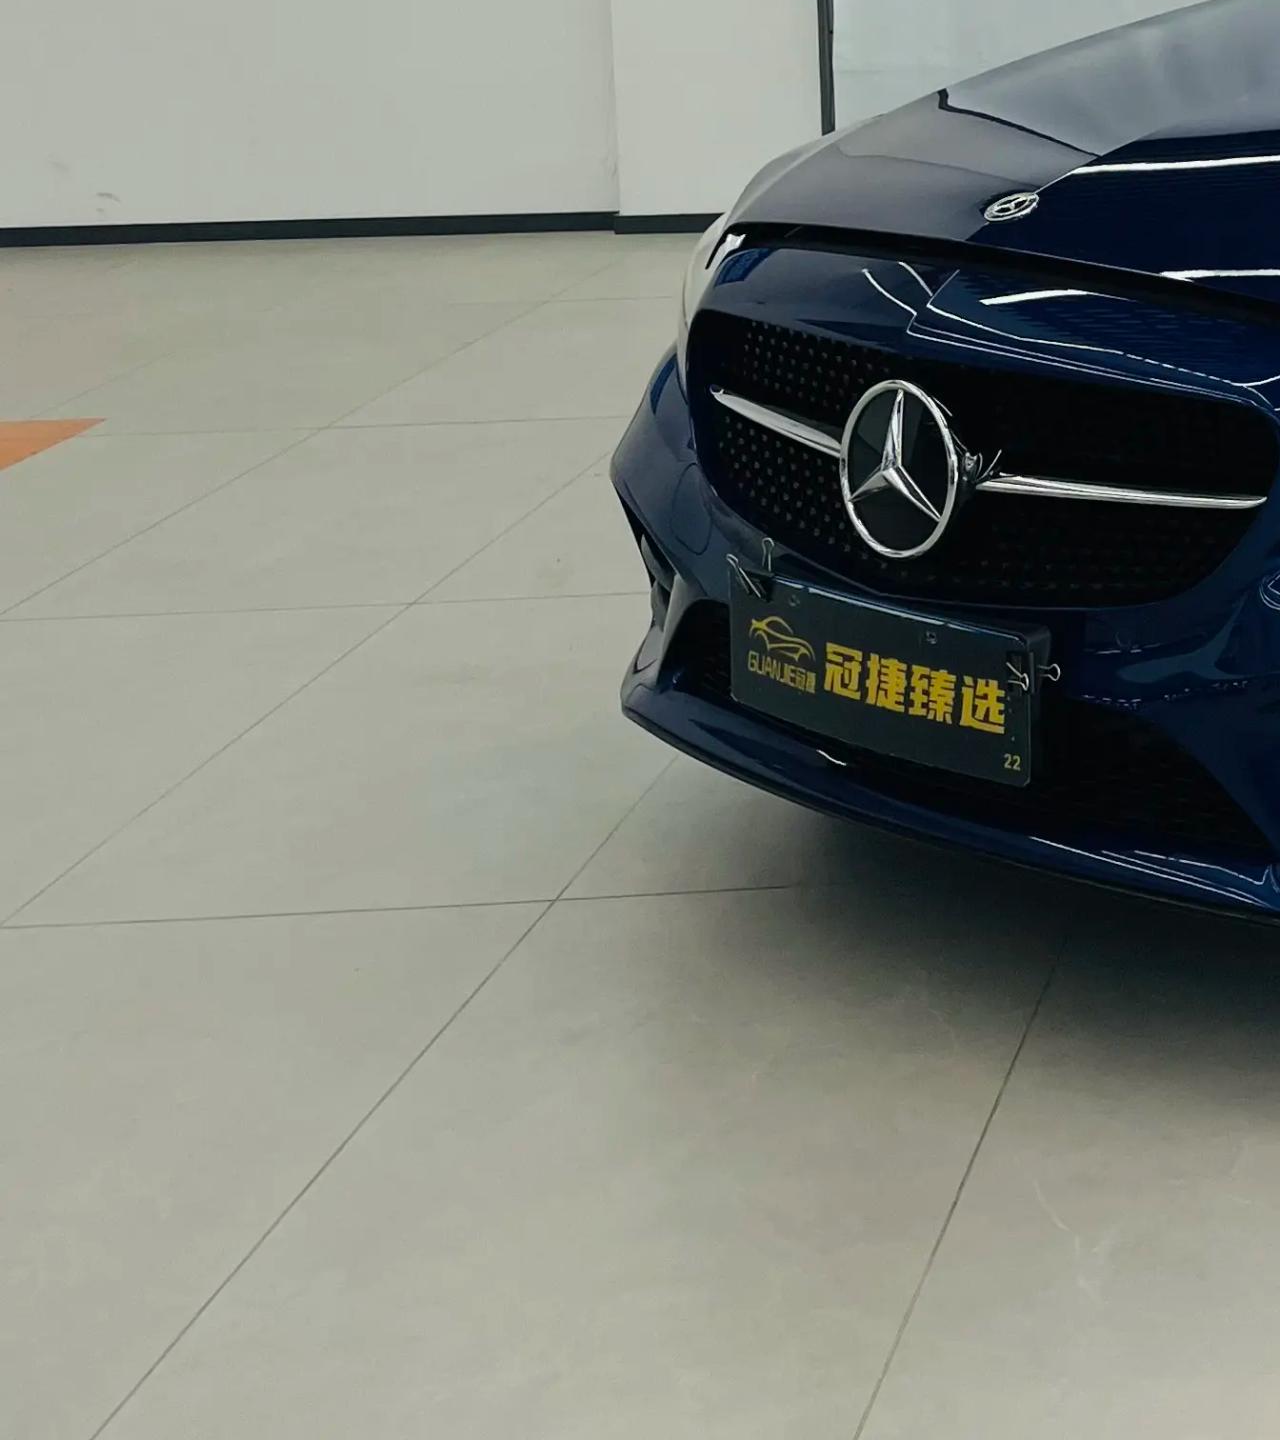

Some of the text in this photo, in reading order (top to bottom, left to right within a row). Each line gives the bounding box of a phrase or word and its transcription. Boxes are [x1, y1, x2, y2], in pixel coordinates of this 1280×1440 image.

[824, 642, 1006, 734] 冠捷臻选
[1003, 753, 1021, 771] 22
